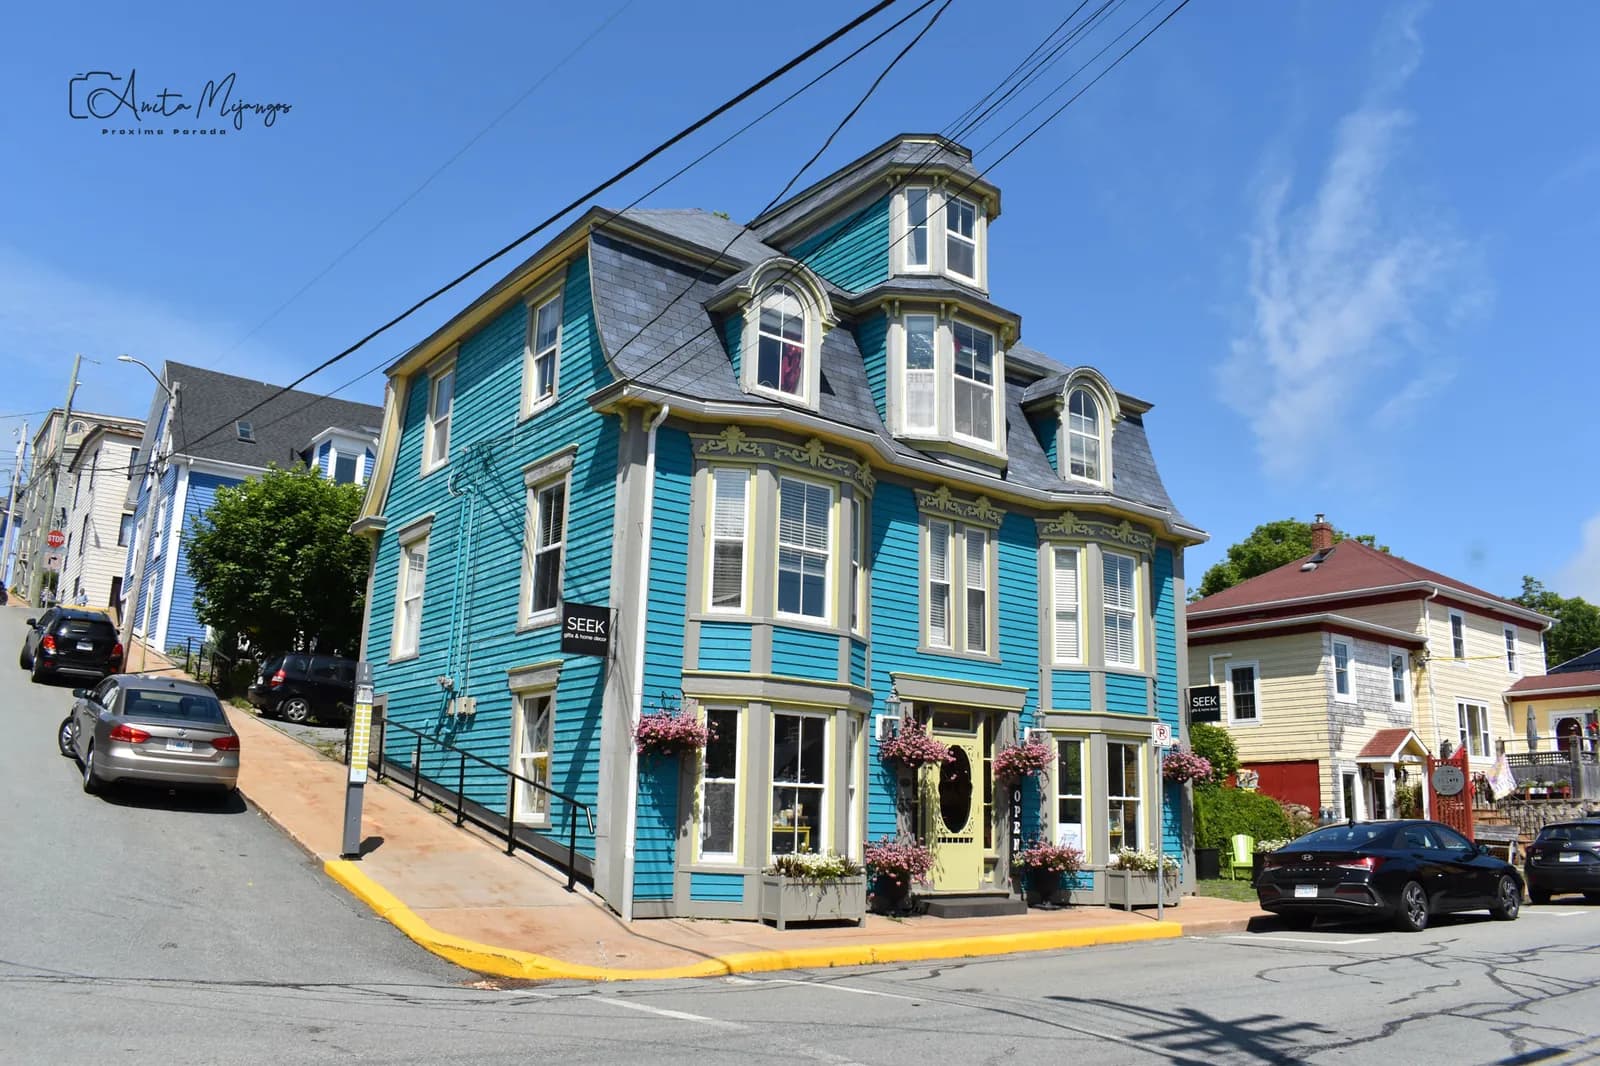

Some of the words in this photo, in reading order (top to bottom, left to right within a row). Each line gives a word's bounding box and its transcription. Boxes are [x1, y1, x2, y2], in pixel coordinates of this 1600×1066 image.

[48, 535, 65, 543] STOP
[567, 616, 606, 634] SEEK
[1192, 695, 1217, 707] SEEK
[1159, 728, 1165, 737] P
[1013, 790, 1021, 851] OPEN
